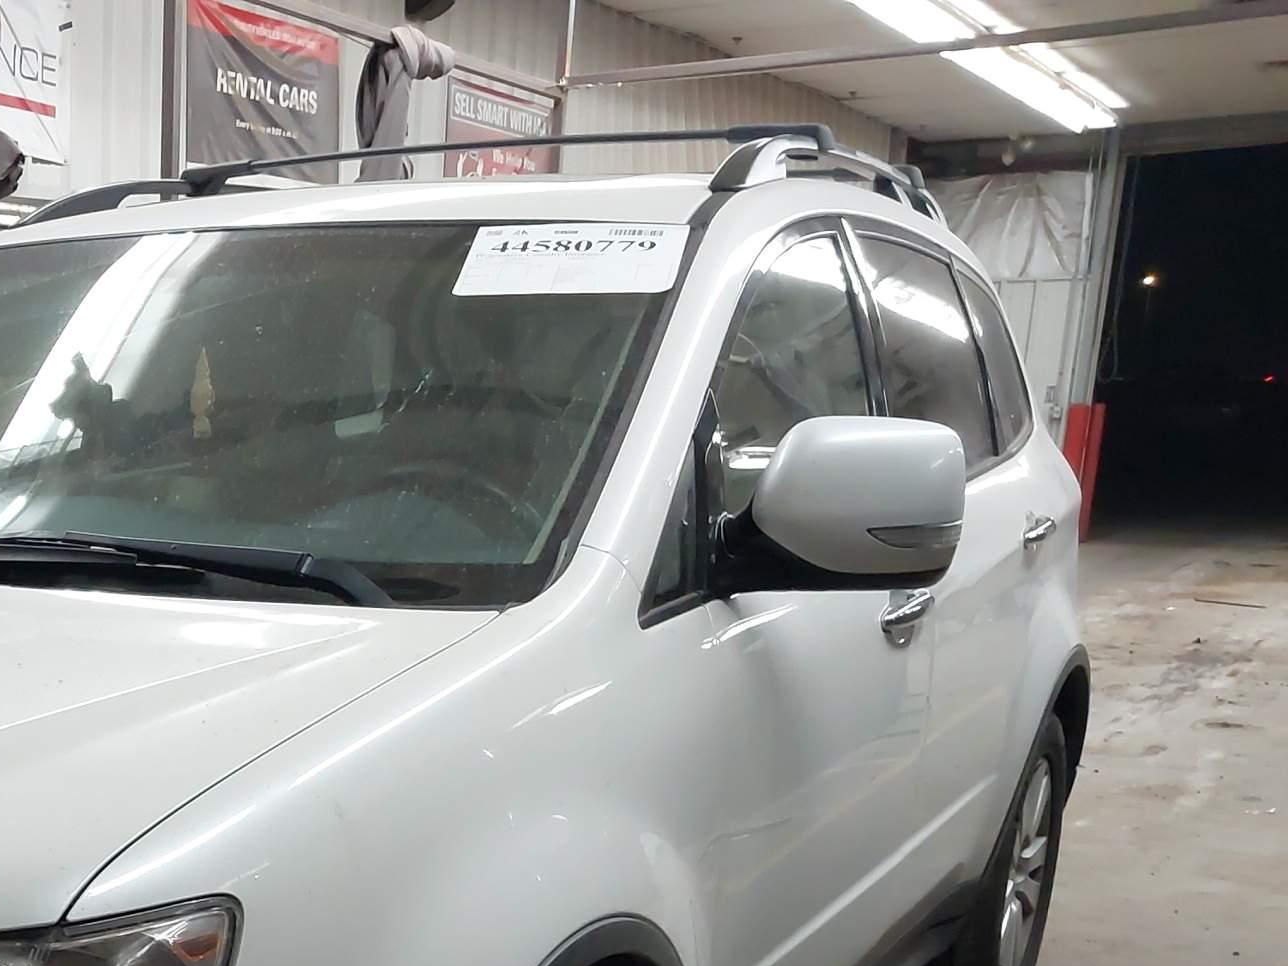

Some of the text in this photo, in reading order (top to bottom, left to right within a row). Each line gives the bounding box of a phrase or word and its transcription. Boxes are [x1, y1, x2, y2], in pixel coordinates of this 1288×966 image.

[216, 68, 317, 114] RENTAL CARS
[455, 92, 475, 118] SELL
[477, 98, 508, 128] SMART
[510, 110, 532, 134] WITH
[490, 239, 658, 253] 44580779
